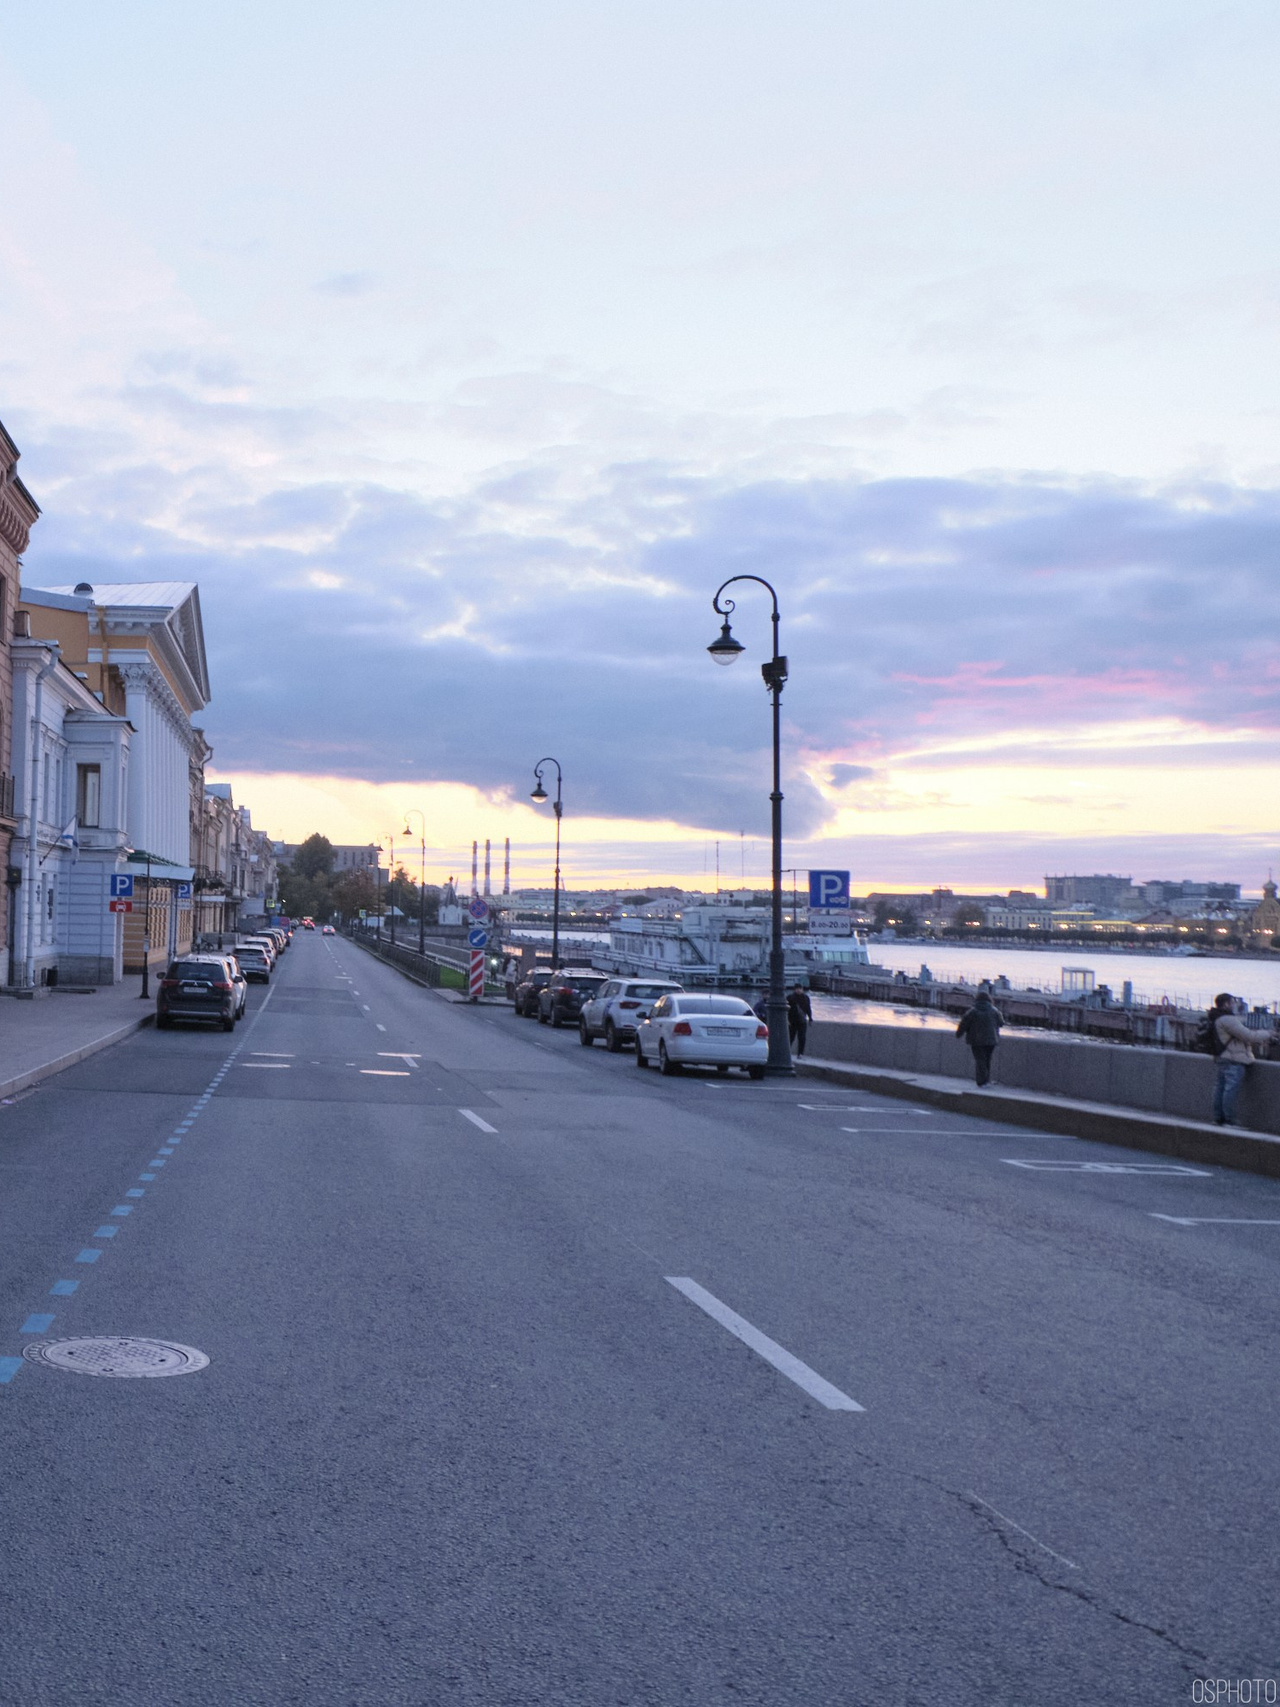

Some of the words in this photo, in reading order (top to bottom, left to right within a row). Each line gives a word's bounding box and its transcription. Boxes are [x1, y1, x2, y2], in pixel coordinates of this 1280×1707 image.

[116, 876, 130, 895] P
[178, 884, 188, 897] P
[820, 874, 843, 905] P
